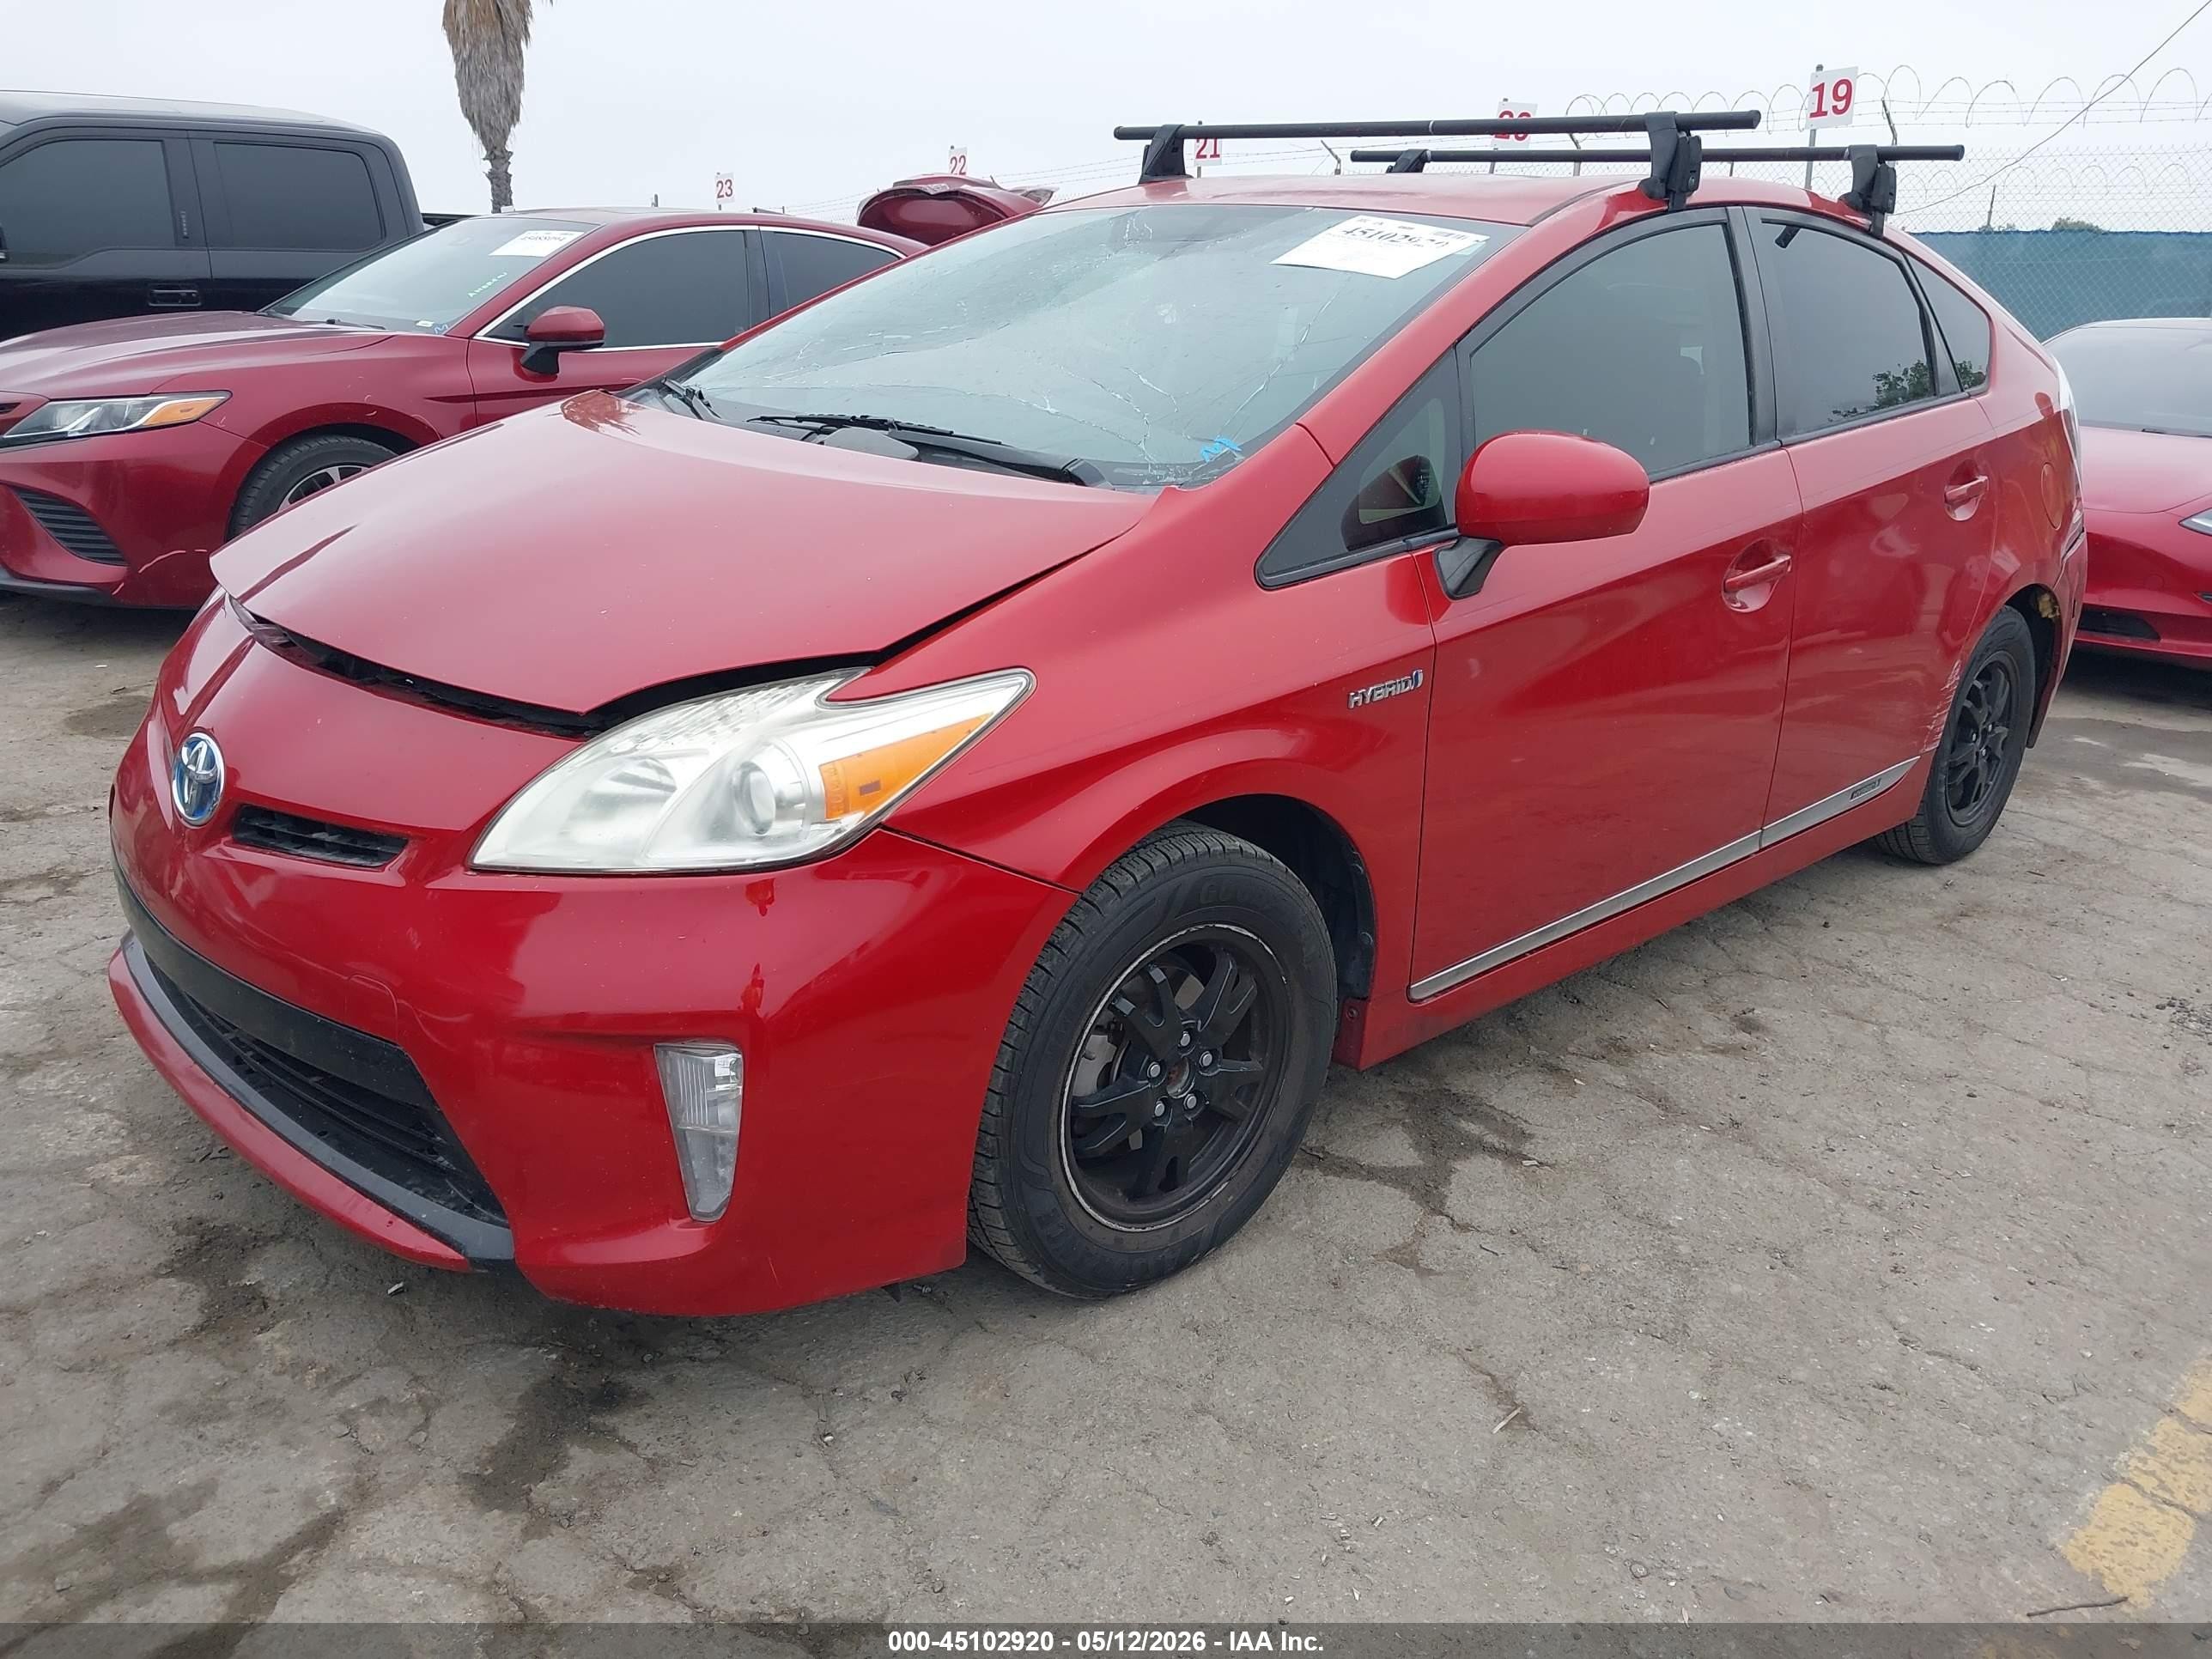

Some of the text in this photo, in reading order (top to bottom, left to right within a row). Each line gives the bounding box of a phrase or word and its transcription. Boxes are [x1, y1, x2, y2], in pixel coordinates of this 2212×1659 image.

[1809, 79, 1852, 118] 19
[1195, 138, 1220, 159] 21
[950, 155, 966, 175] 22
[716, 179, 733, 198] 23
[1348, 675, 1414, 709] HYBRID
